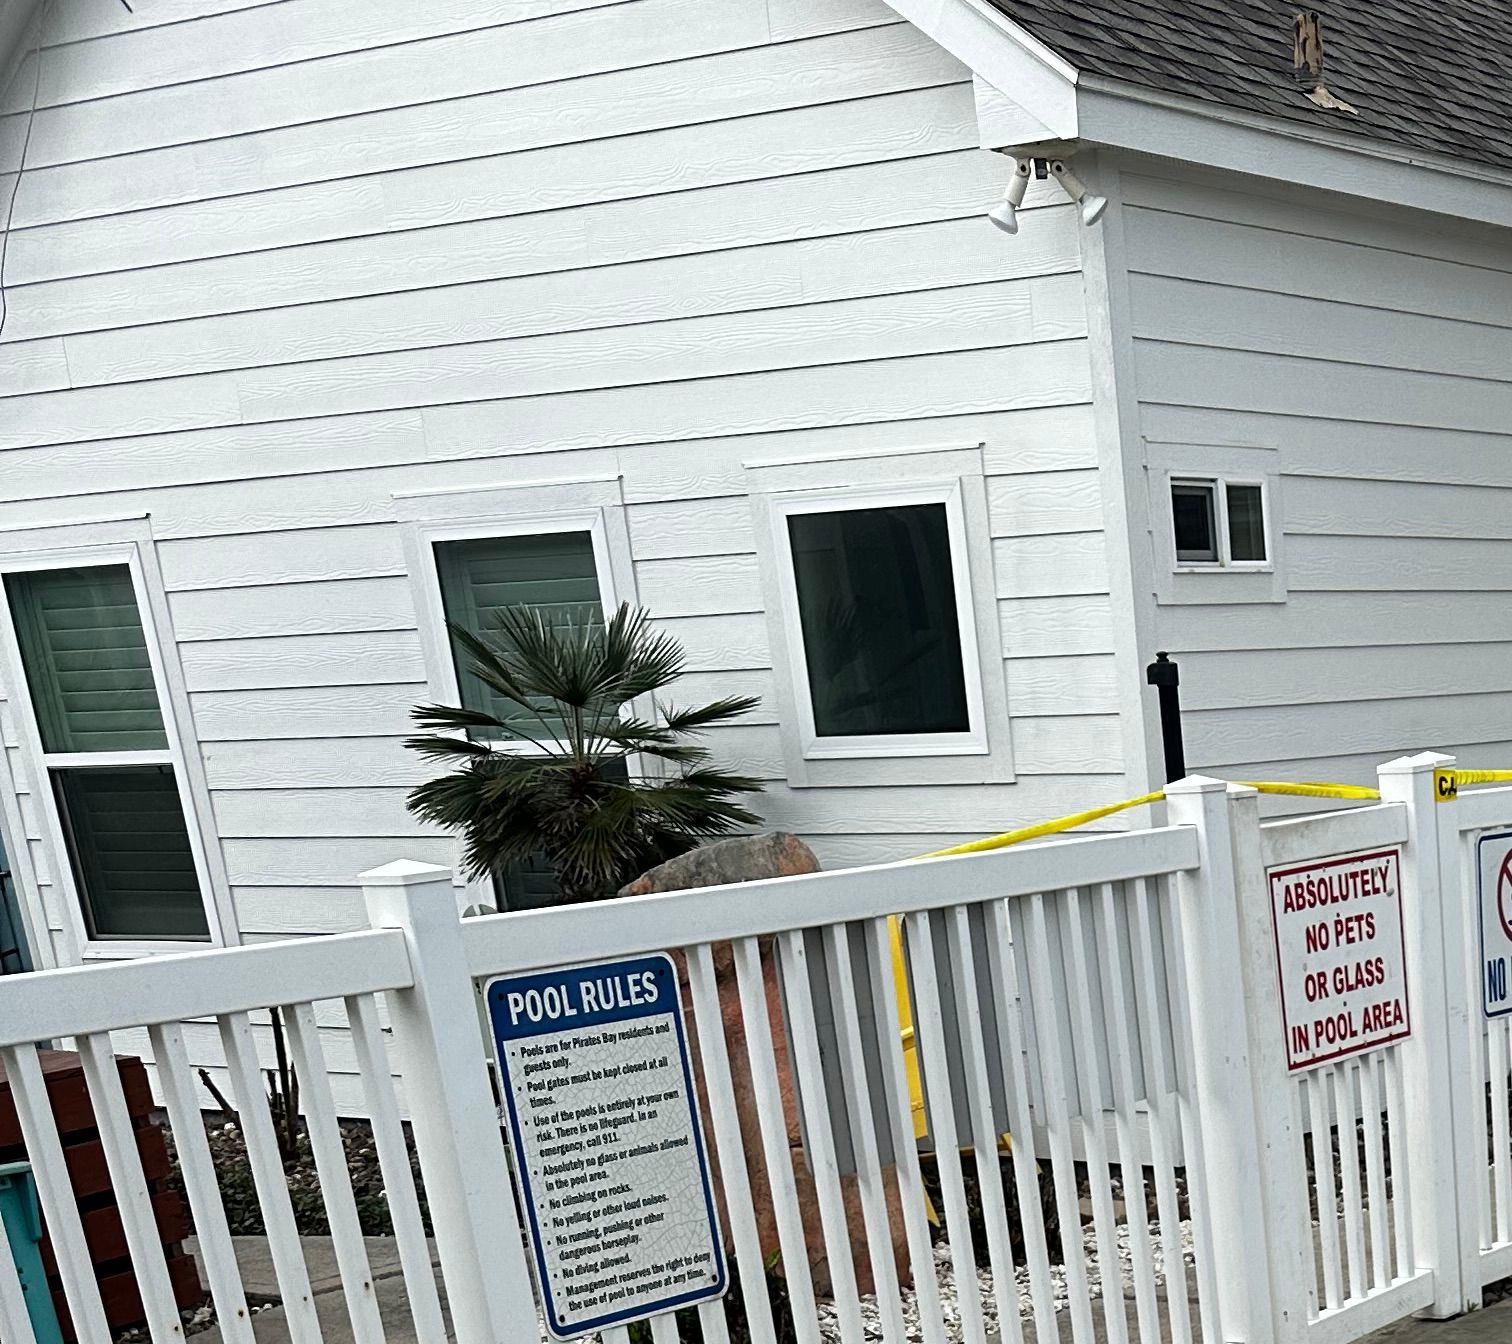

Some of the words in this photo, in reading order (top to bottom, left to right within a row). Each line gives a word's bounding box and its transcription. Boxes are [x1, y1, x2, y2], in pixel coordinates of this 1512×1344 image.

[1283, 865, 1389, 914] ABSOLUTELY
[1305, 925, 1329, 954] NO
[1335, 912, 1376, 947] PETS
[1304, 971, 1329, 1002] OR
[1332, 957, 1385, 992] GLASS
[1488, 957, 1506, 1003] NO
[507, 984, 577, 1026] POOL
[579, 971, 659, 1014] RULES
[520, 1045, 544, 1058] Pools
[545, 1044, 558, 1054] are
[559, 1040, 571, 1051] for
[572, 1036, 601, 1049] Pirates
[602, 1032, 617, 1044] Bay
[618, 1025, 654, 1041] residents
[655, 1022, 670, 1034] and
[1292, 1023, 1309, 1054] IN
[1314, 1012, 1358, 1045] POOL
[1362, 999, 1404, 1034] AREA
[523, 1060, 552, 1076] guests
[552, 1056, 571, 1069] only.
[527, 1079, 546, 1092] Pool
[547, 1077, 570, 1091] gates
[571, 1071, 592, 1084] must
[591, 1070, 602, 1080] be
[603, 1065, 622, 1079] kept
[622, 1060, 648, 1075] closed
[649, 1058, 658, 1069] at
[658, 1056, 668, 1068] all
[529, 1096, 556, 1108] times.
[533, 1116, 549, 1127] Use
[551, 1112, 559, 1124] of
[560, 1110, 574, 1121] the
[575, 1105, 597, 1120] pools
[598, 1103, 606, 1114] is
[607, 1097, 635, 1112] entirely
[637, 1095, 646, 1106] at
[645, 1094, 662, 1106] your
[663, 1090, 679, 1101] own
[537, 1130, 555, 1142] risk.
[555, 1126, 578, 1139] There
[579, 1123, 587, 1133] is
[588, 1122, 598, 1131] no
[599, 1112, 637, 1129] lifeguard.
[637, 1111, 646, 1121] In
[647, 1110, 658, 1119] an
[539, 1141, 585, 1158] emergency,
[586, 1135, 602, 1148] call
[602, 1132, 621, 1144] 911.
[543, 1158, 584, 1176] Absolutely
[586, 1158, 596, 1167] no
[597, 1153, 618, 1167] glass
[619, 1150, 628, 1160] or
[628, 1142, 659, 1157] animals
[660, 1135, 688, 1151] allowed
[545, 1181, 554, 1191] in
[555, 1178, 569, 1189] the
[570, 1172, 588, 1188] pool
[589, 1171, 609, 1182] area.
[549, 1199, 561, 1209] No
[562, 1191, 597, 1207] climbing
[597, 1189, 608, 1199] on
[608, 1184, 632, 1196] rocks.
[552, 1217, 564, 1228] No
[565, 1211, 592, 1227] yelling
[592, 1209, 601, 1218] or
[602, 1204, 622, 1216] other
[623, 1198, 641, 1211] loud
[642, 1194, 669, 1206] noises.
[556, 1235, 568, 1246] No
[569, 1228, 602, 1243] running,
[603, 1219, 634, 1236] pushing
[635, 1218, 642, 1227] or
[644, 1213, 664, 1225] other
[559, 1244, 601, 1261] dangerous
[601, 1234, 641, 1250] horseplay.
[562, 1268, 574, 1279] No
[575, 1262, 600, 1275] diving
[600, 1253, 631, 1270] allowed.
[565, 1274, 618, 1297] Management
[619, 1268, 651, 1283] reserves
[651, 1264, 664, 1274] the
[666, 1257, 684, 1272] right
[684, 1257, 692, 1266] to
[693, 1252, 710, 1264] deny
[568, 1300, 582, 1311] the
[583, 1297, 598, 1308] use
[599, 1292, 607, 1304] of
[608, 1287, 626, 1303] pool
[626, 1287, 635, 1296] to
[636, 1280, 662, 1294] anyone
[664, 1275, 672, 1286] at
[673, 1274, 686, 1284] any
[687, 1269, 706, 1280] time.
